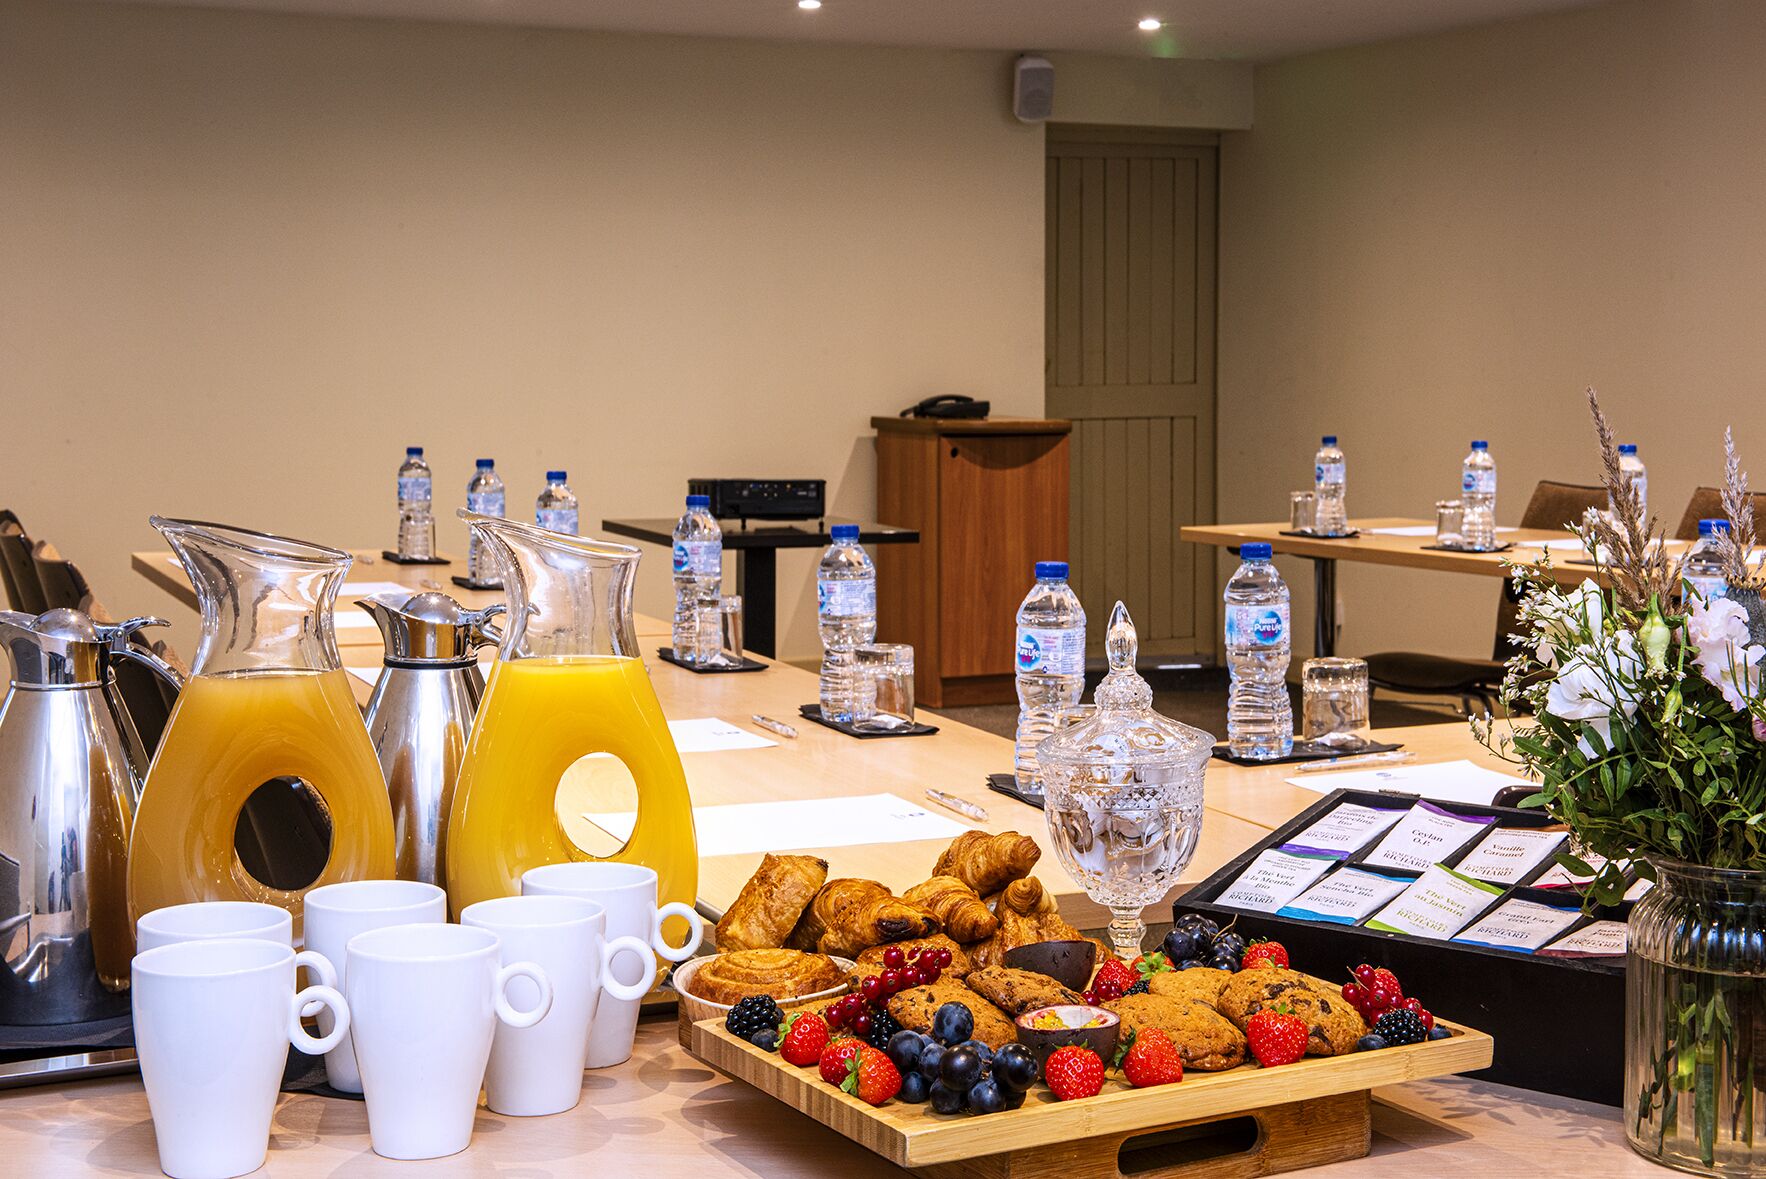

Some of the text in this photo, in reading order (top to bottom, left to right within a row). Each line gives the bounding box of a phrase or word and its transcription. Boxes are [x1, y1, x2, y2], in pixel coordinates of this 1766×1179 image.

[1254, 623, 1271, 631] Pure
[1411, 829, 1443, 843] Ceylan
[1483, 848, 1524, 858] Caramel
[1492, 843, 1526, 852] Vanille
[1383, 852, 1430, 869] RICHARD
[1275, 872, 1295, 880] Vert
[1464, 865, 1512, 876] RICHARD
[1261, 877, 1296, 887] Menthe
[1228, 893, 1273, 905] RICHARD
[1307, 896, 1357, 908] RICHARD
[1445, 896, 1467, 910] Vert
[1396, 910, 1446, 933] RICHARD
[1477, 927, 1529, 939] RICHARD
